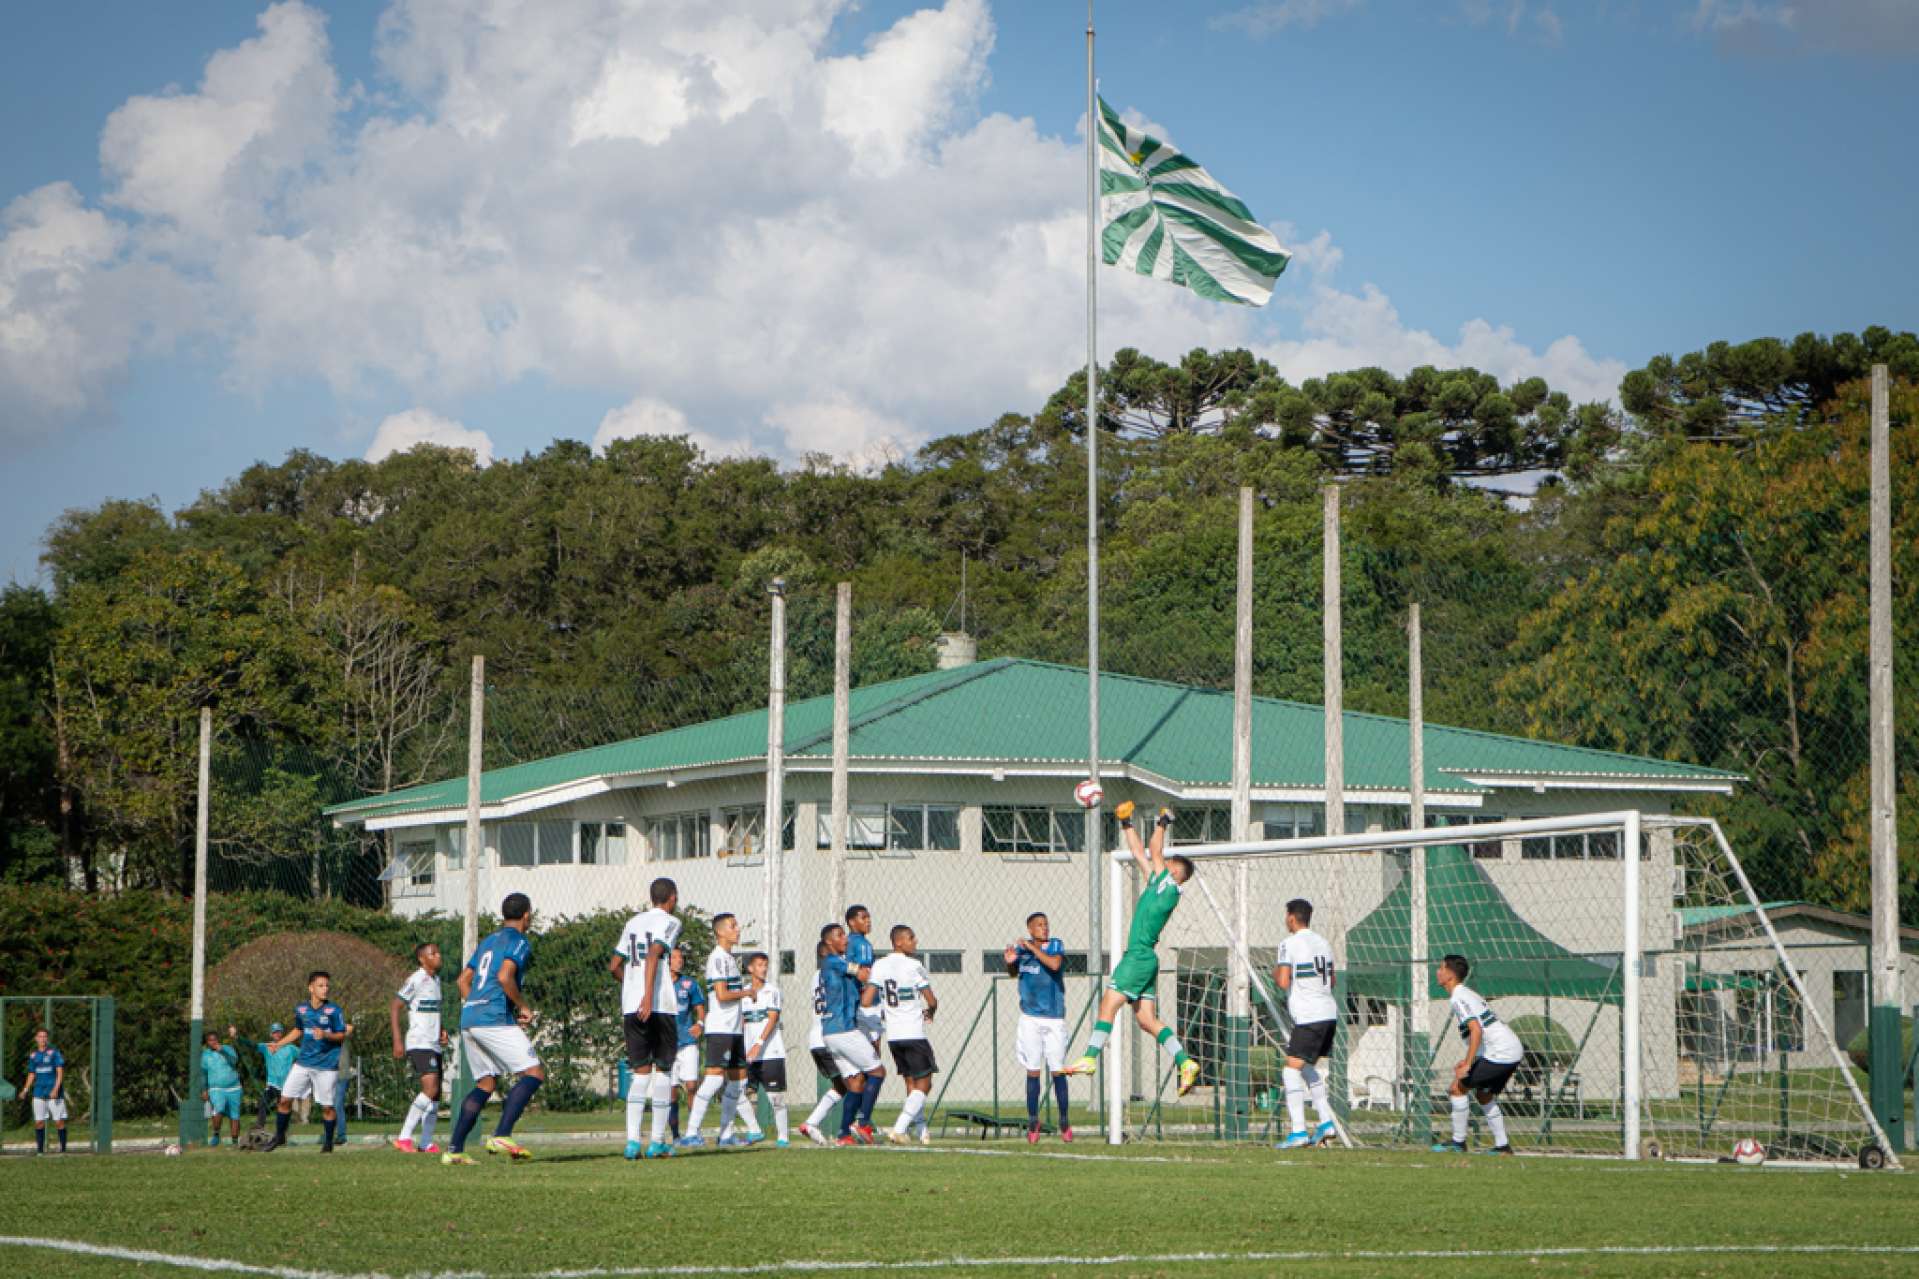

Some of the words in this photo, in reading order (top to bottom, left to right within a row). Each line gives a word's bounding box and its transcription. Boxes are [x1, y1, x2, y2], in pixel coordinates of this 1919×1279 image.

[477, 950, 493, 990] 9
[1313, 956, 1328, 985] 4
[884, 978, 899, 1008] 6
